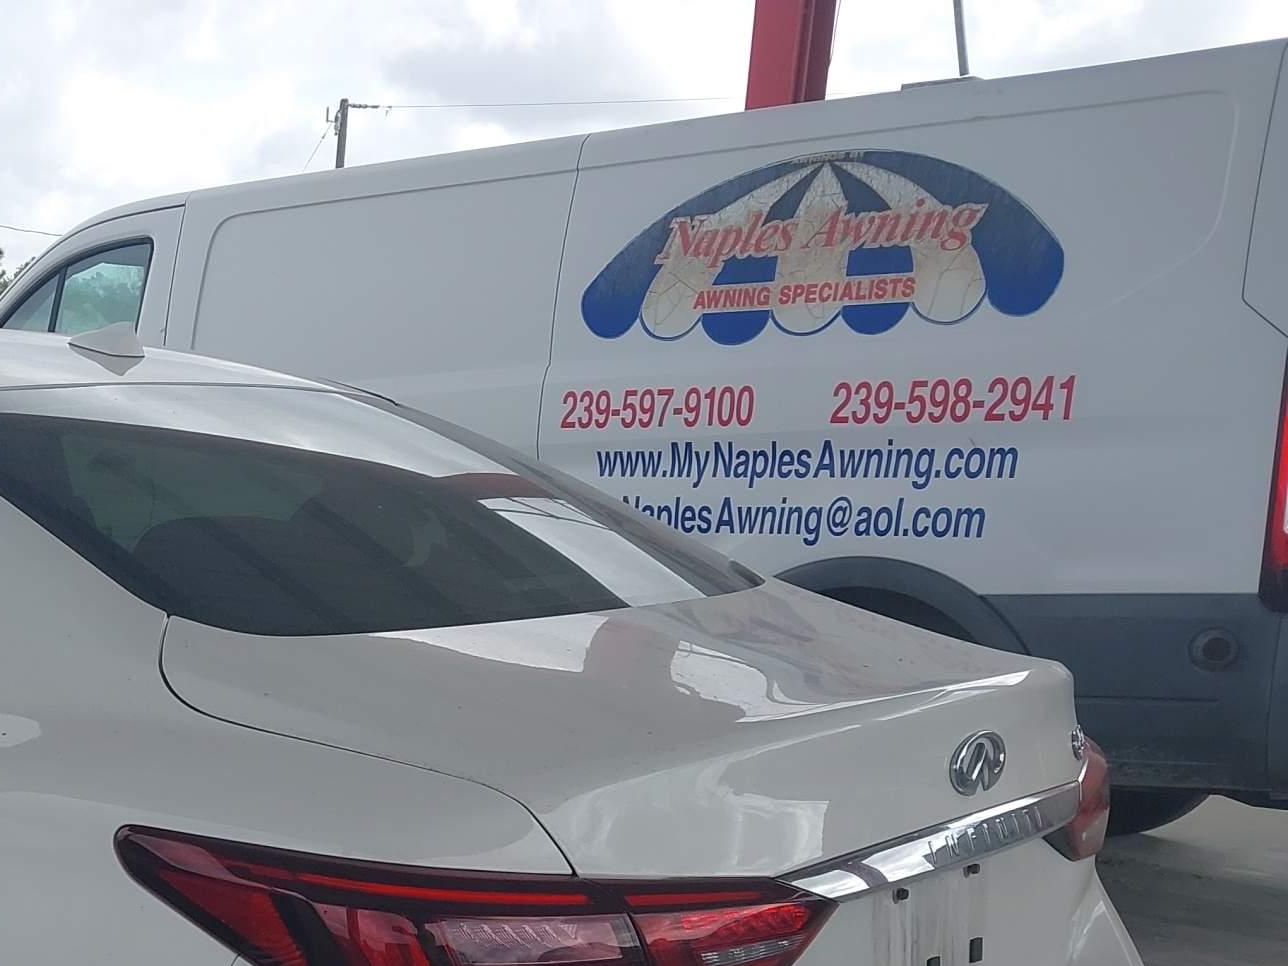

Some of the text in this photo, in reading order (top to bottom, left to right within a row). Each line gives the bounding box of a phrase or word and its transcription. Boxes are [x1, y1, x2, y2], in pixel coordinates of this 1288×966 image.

[660, 198, 983, 268] Naples Awning
[693, 277, 916, 310] AWNING SPECIALISTS
[560, 385, 755, 430] 239-597-9100
[830, 375, 1076, 425] 239-598-2941
[596, 439, 1019, 490] www.MyNaplesAwning.com
[622, 495, 986, 546] lesAwning@aol.com
[927, 805, 1045, 866] INFINITI
